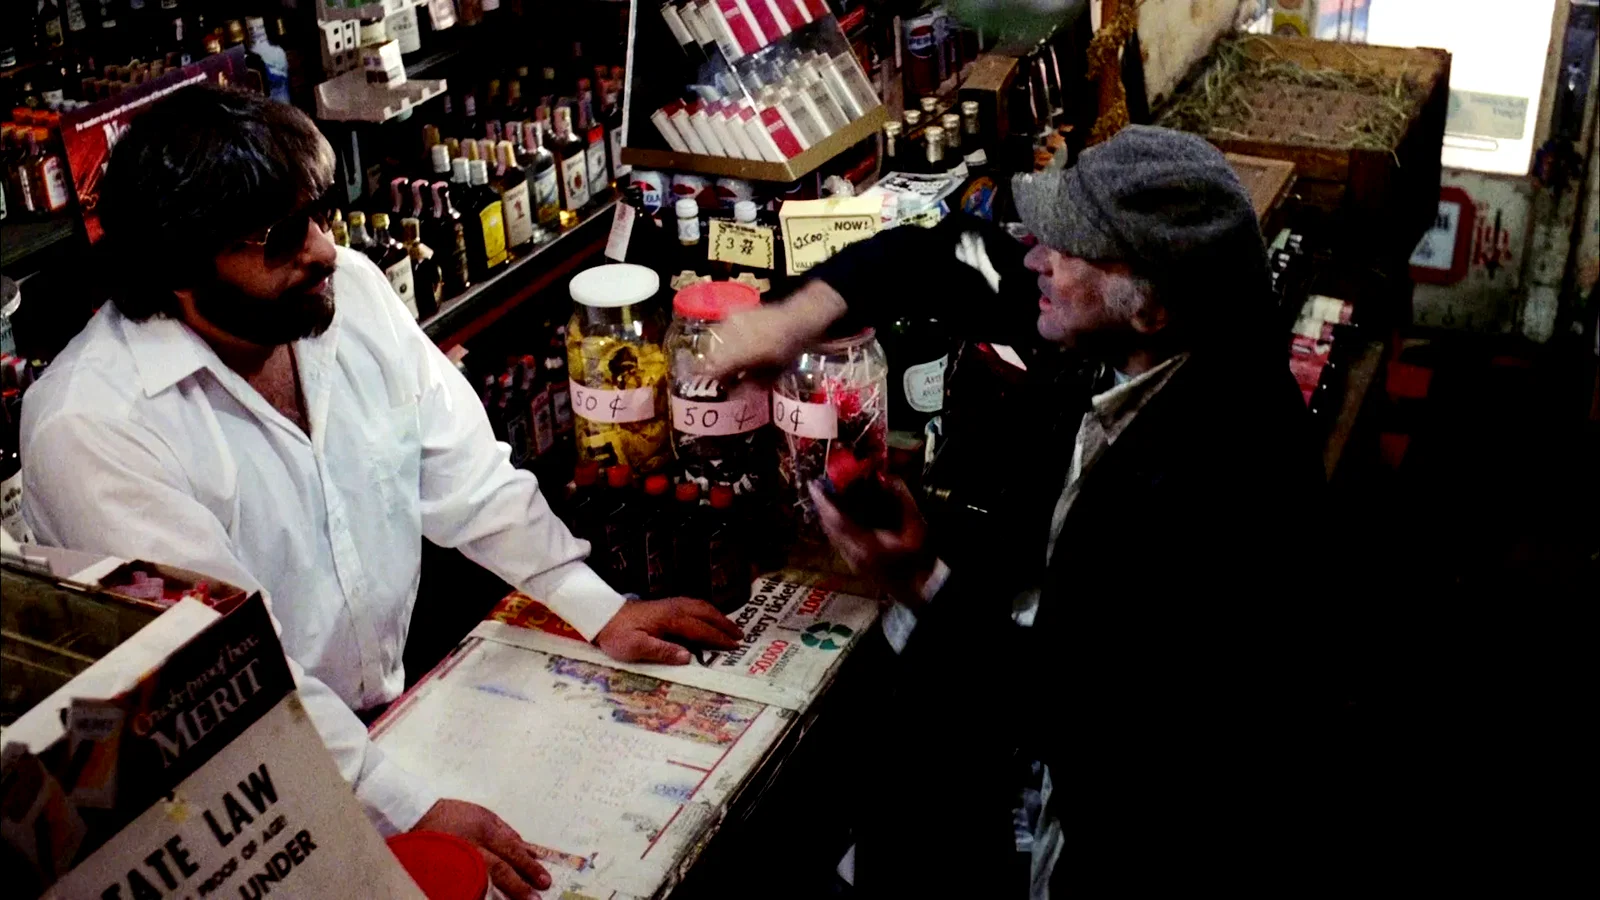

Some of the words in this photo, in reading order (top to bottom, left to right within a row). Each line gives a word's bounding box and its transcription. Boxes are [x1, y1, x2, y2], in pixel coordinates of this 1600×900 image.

[834, 221, 869, 232] NOW!
[575, 390, 598, 411] 50
[684, 407, 719, 428] 50
[753, 593, 768, 612] to
[743, 613, 779, 644] every
[150, 656, 264, 770] MERIT
[100, 834, 201, 900] TATE
[203, 763, 279, 848] LAW
[198, 856, 239, 897] PROOF
[241, 840, 258, 860] OF
[238, 829, 319, 900] UNDER
